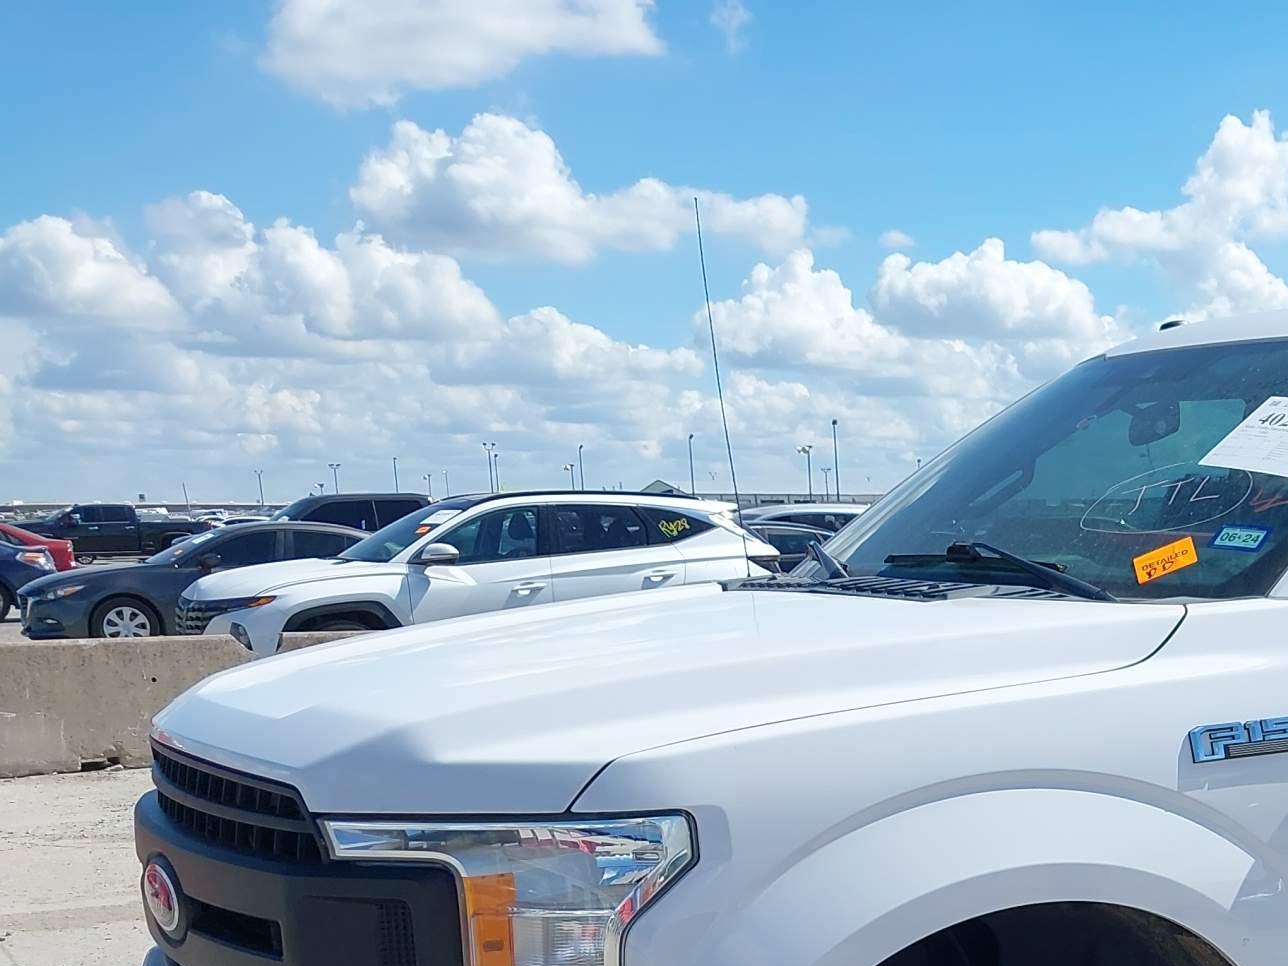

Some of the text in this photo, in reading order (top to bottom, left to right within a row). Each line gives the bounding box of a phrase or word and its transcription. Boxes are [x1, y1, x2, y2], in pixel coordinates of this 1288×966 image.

[1220, 532, 1260, 544] 06 24
[1141, 549, 1189, 571] DETAILED
